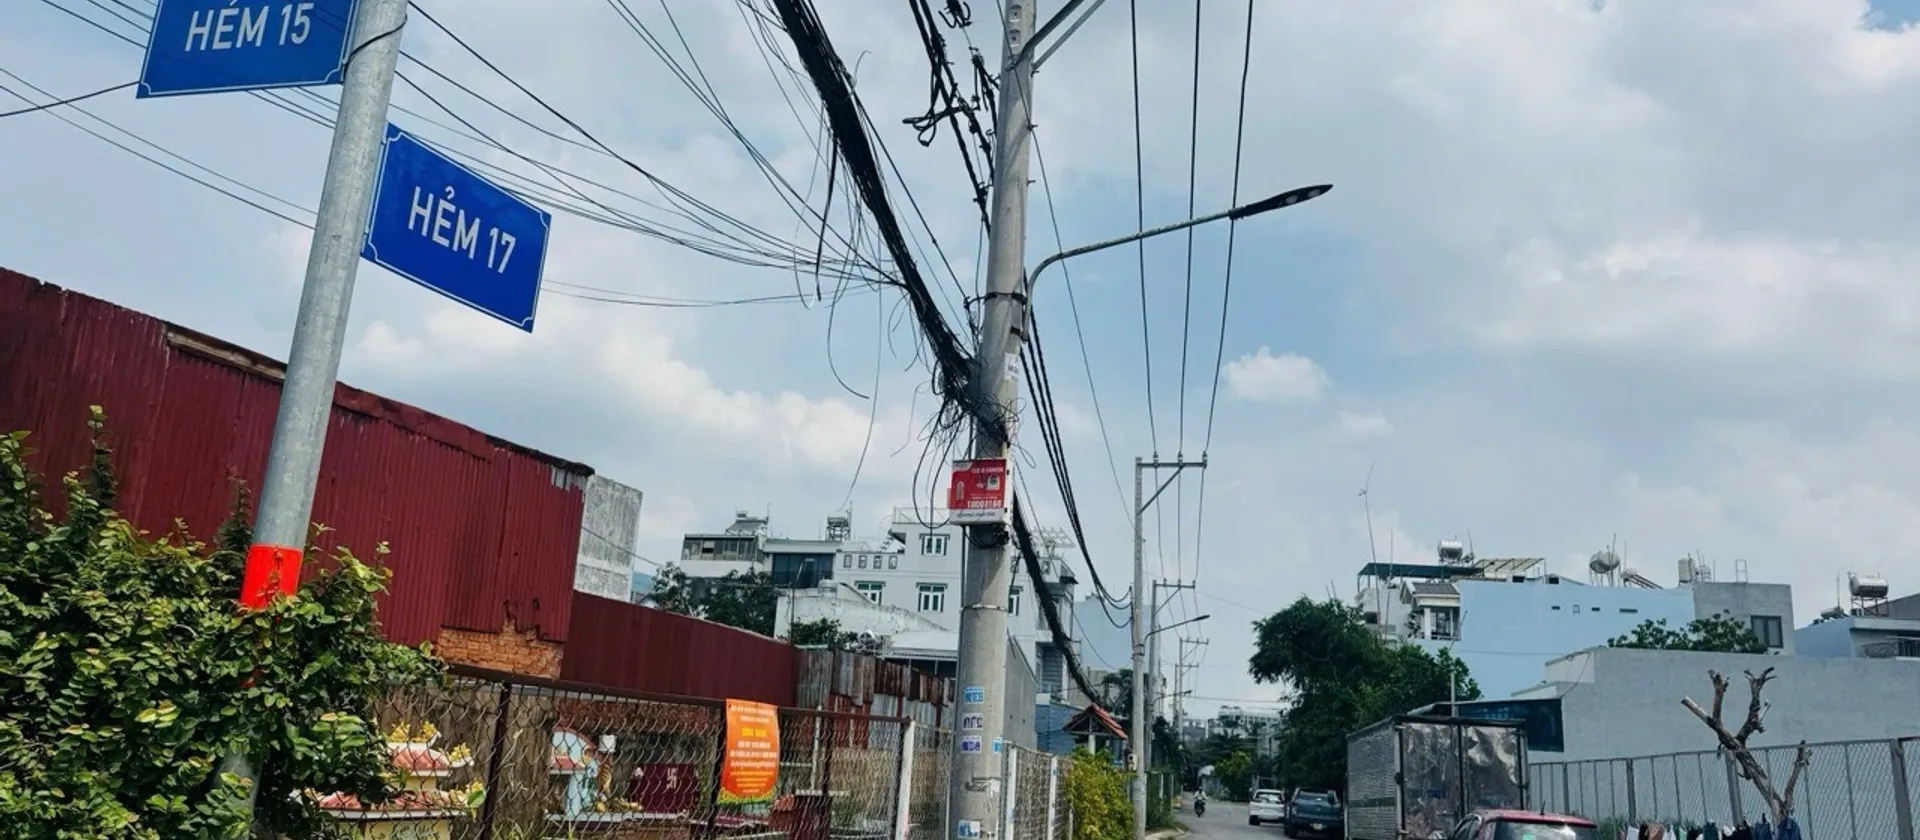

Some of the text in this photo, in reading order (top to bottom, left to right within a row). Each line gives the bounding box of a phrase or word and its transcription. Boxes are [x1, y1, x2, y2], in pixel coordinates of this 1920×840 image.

[279, 2, 314, 46] 15
[408, 185, 516, 274] HẺM 17
